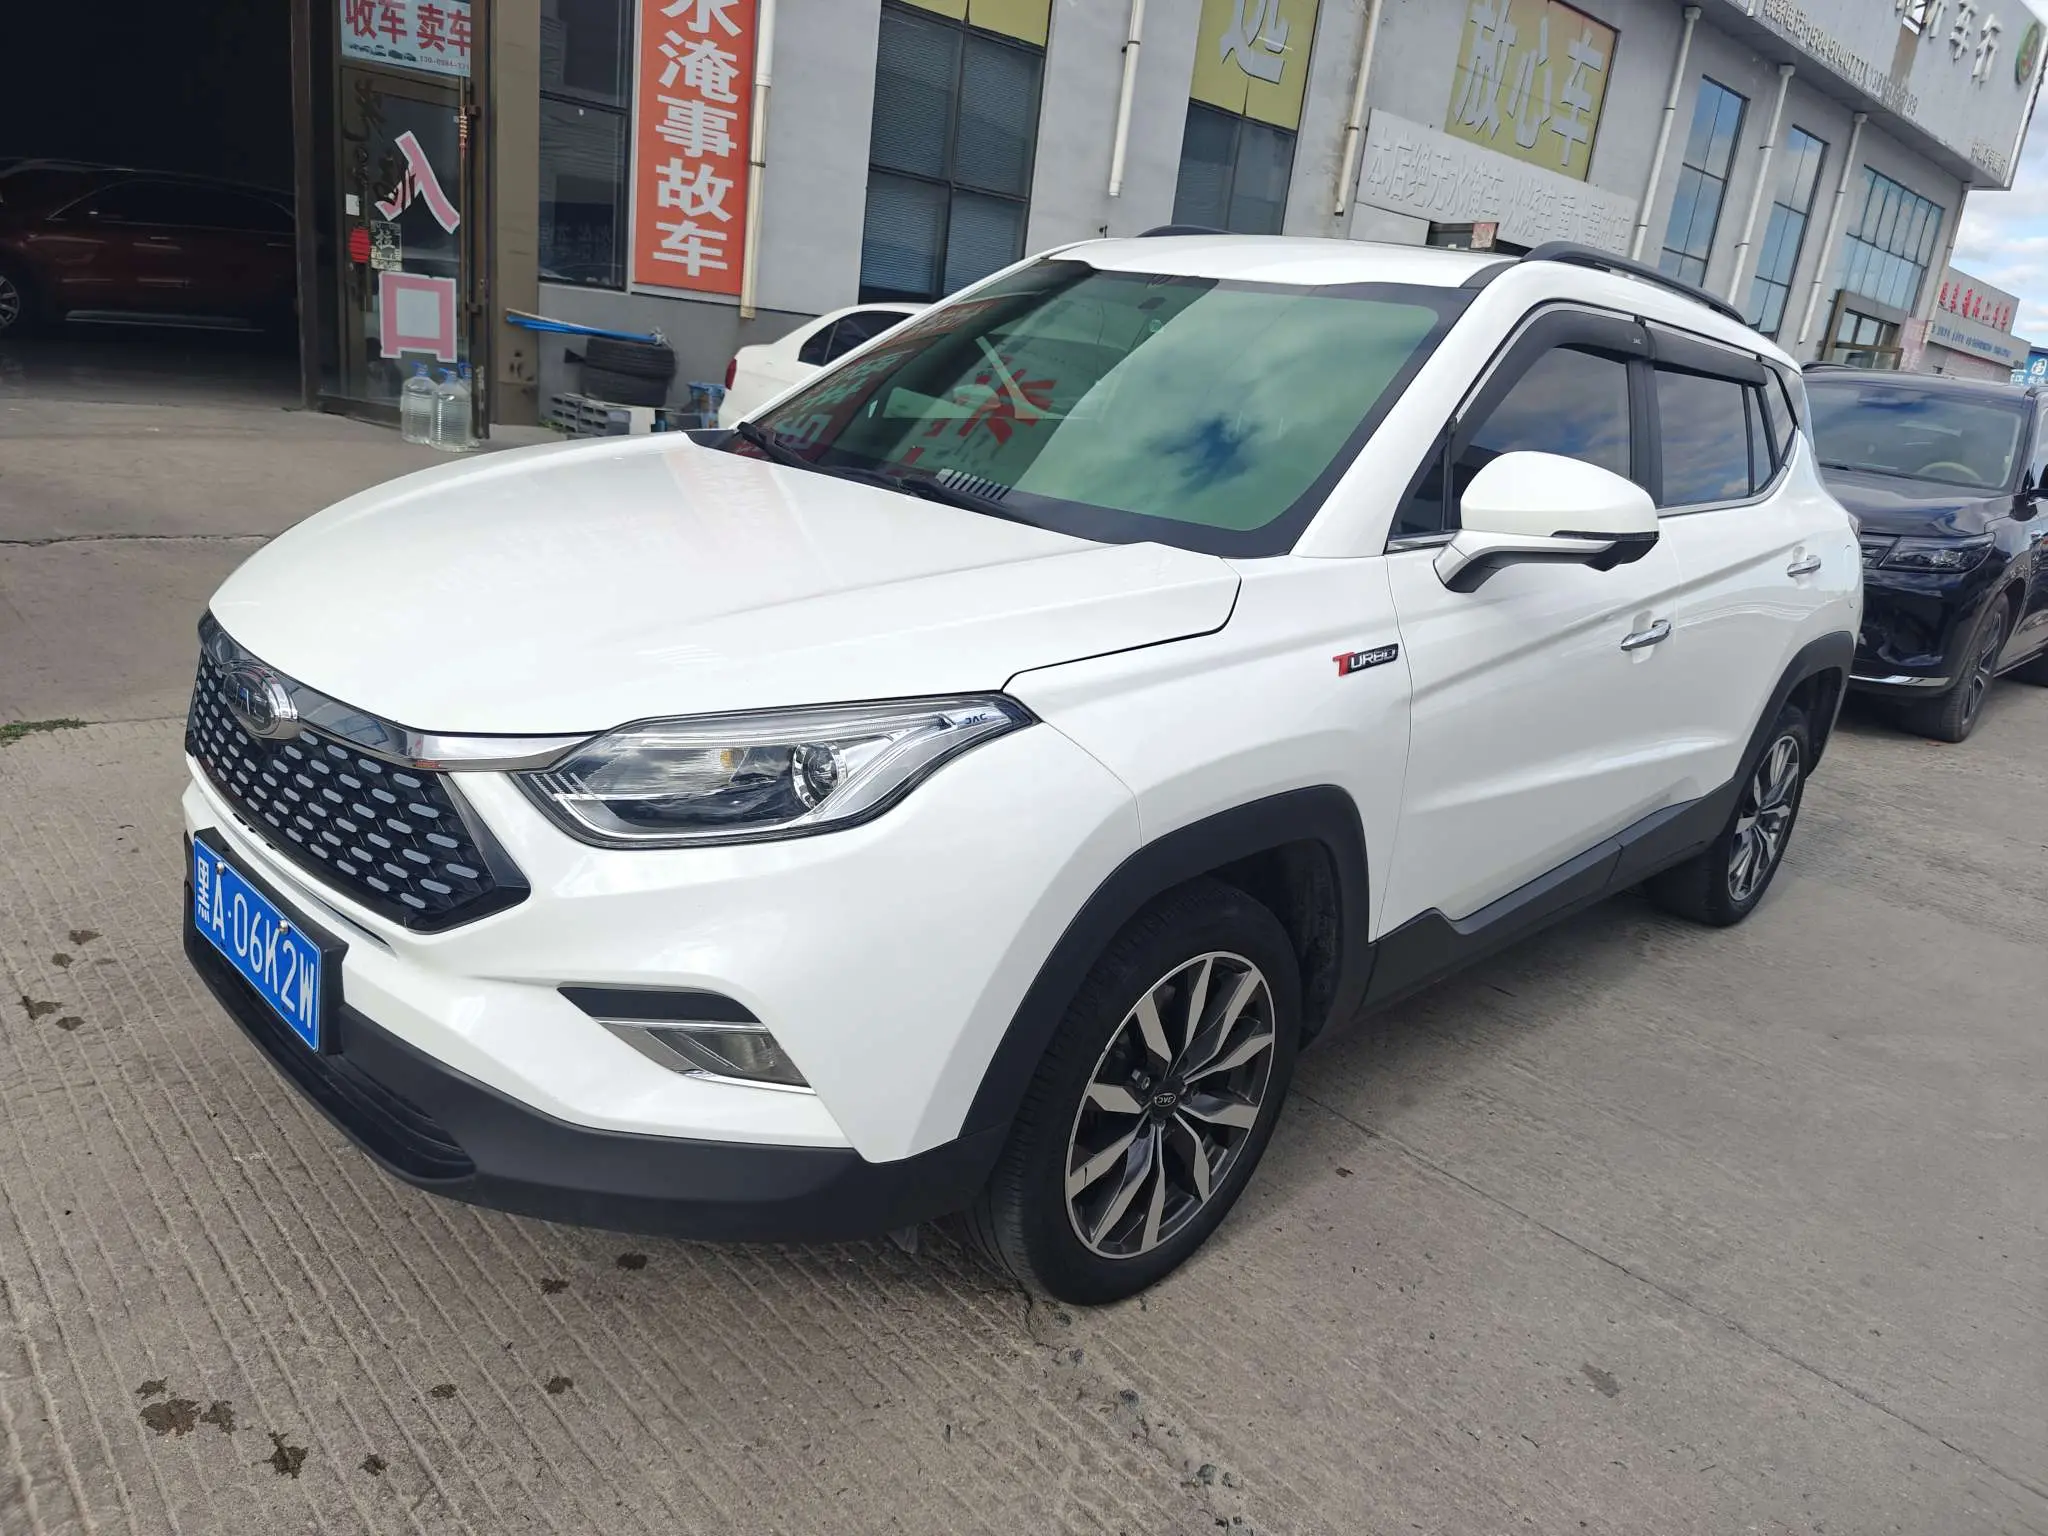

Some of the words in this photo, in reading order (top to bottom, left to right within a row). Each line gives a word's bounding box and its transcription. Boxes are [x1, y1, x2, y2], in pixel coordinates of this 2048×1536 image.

[346, 0, 408, 45] 收车
[416, 3, 471, 57] 卖车
[1455, 0, 1604, 166] 放心车
[653, 0, 743, 276] 水淹事故车
[1332, 648, 1397, 677] TURBO
[965, 713, 988, 725] JAC
